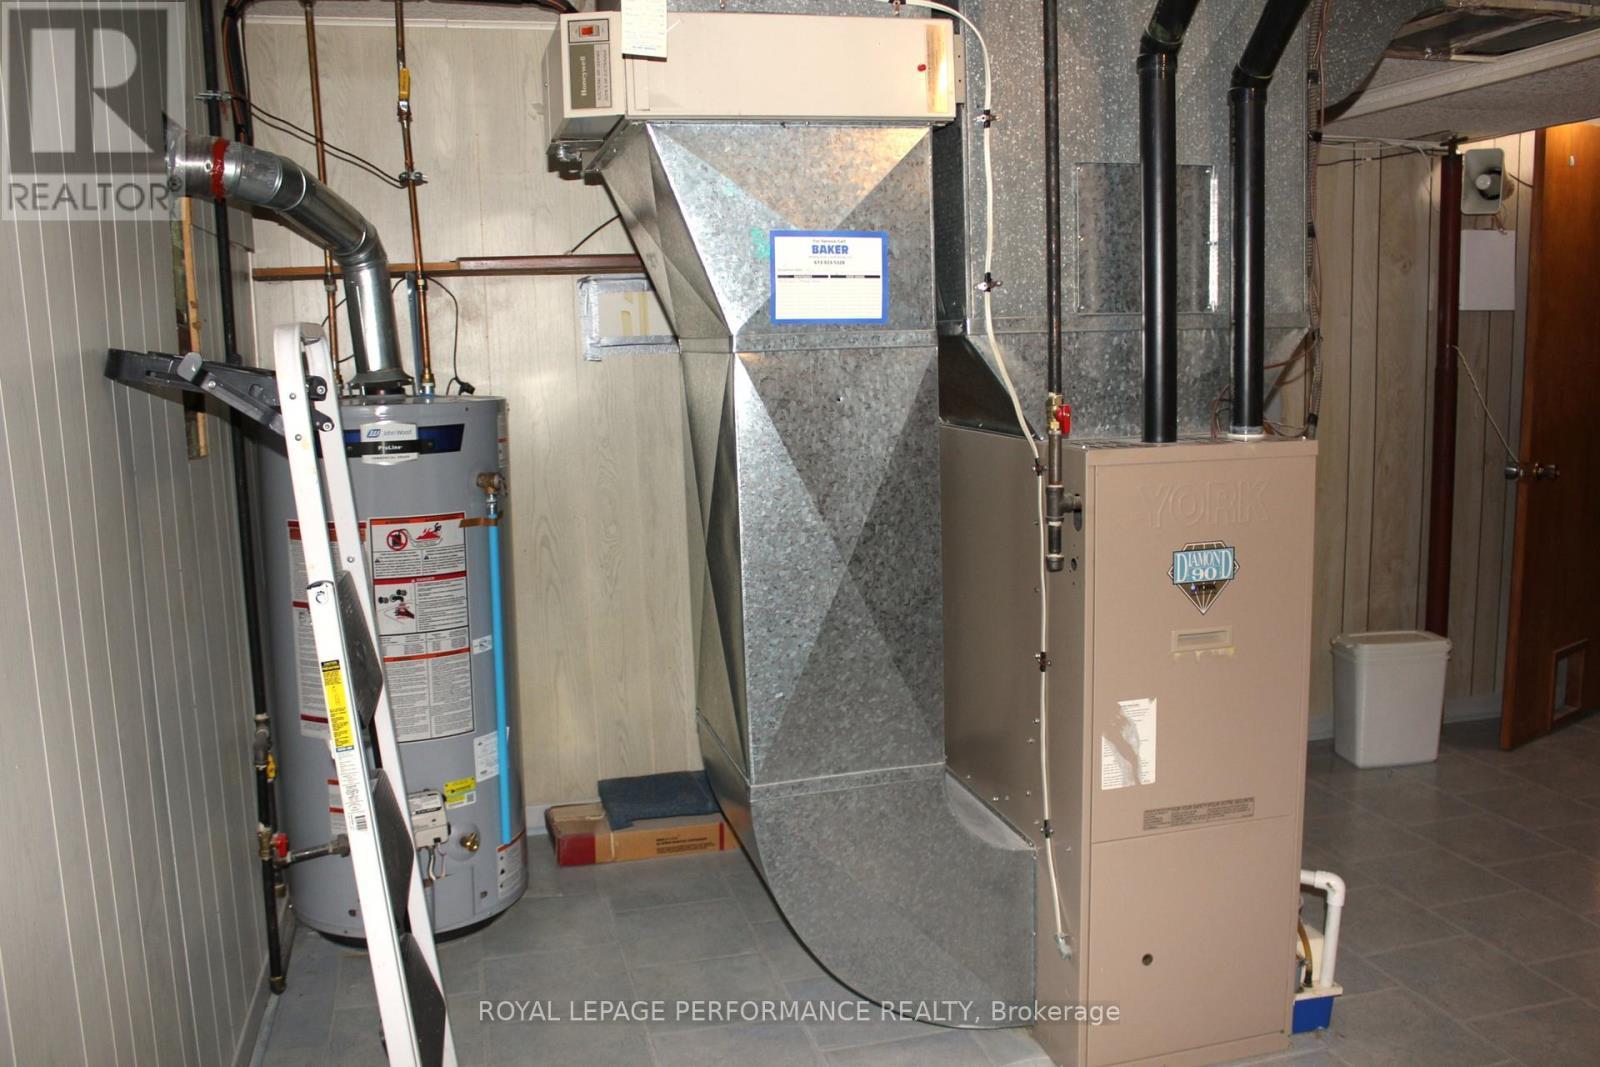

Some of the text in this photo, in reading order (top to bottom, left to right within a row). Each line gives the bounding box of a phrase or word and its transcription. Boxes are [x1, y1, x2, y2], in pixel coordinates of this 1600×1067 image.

[580, 56, 588, 96] Honeywell
[812, 245, 849, 254] BAKER
[1138, 479, 1271, 528] YORK
[1176, 549, 1232, 582] DIAMOND
[1191, 567, 1217, 581] 90
